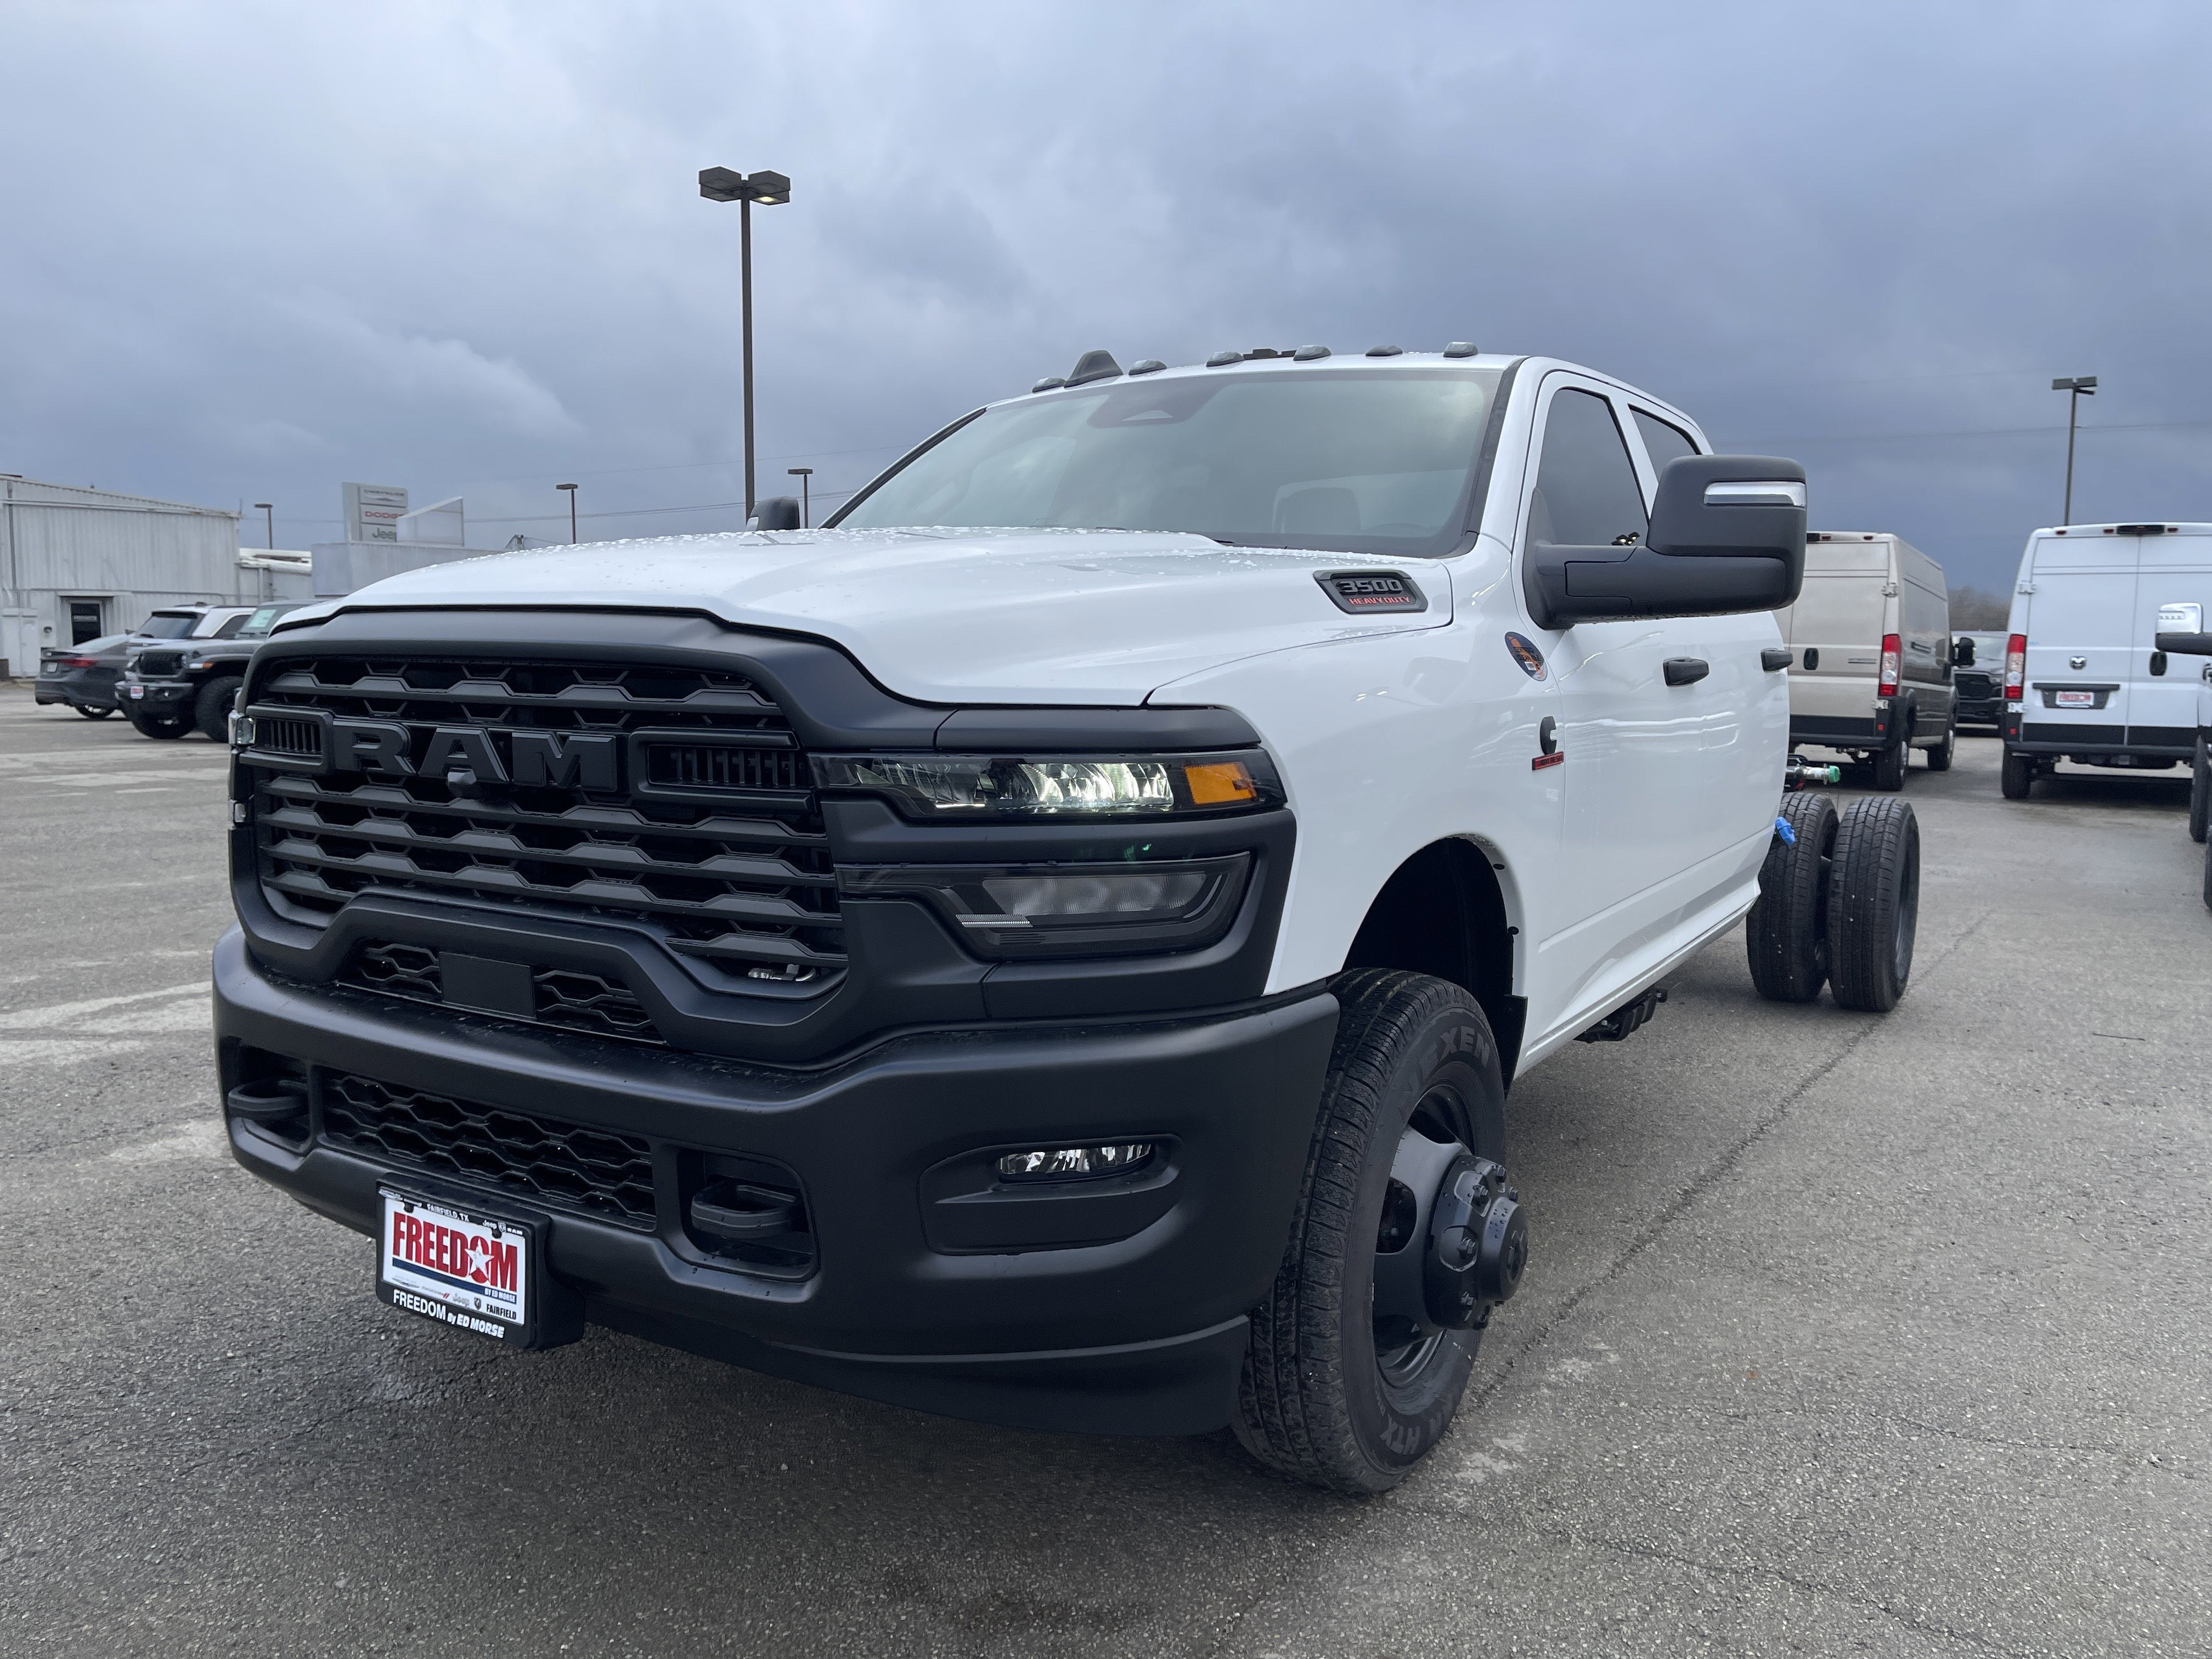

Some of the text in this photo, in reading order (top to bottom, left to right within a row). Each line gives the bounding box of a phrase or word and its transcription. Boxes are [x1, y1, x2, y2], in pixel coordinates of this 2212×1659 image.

[1336, 579, 1403, 595] 3500
[1348, 596, 1410, 605] HEAVY DUTY
[332, 720, 618, 792] RAM
[459, 1212, 469, 1222] TX
[482, 1220, 497, 1229] Jeep
[393, 1211, 517, 1293] FREEDOM
[484, 1288, 516, 1303] BY ED MORSE
[393, 1289, 447, 1321] FREEDOM
[456, 1313, 470, 1328] ED
[470, 1317, 505, 1339] MORSE
[487, 1304, 516, 1320] FAIRFIELD
